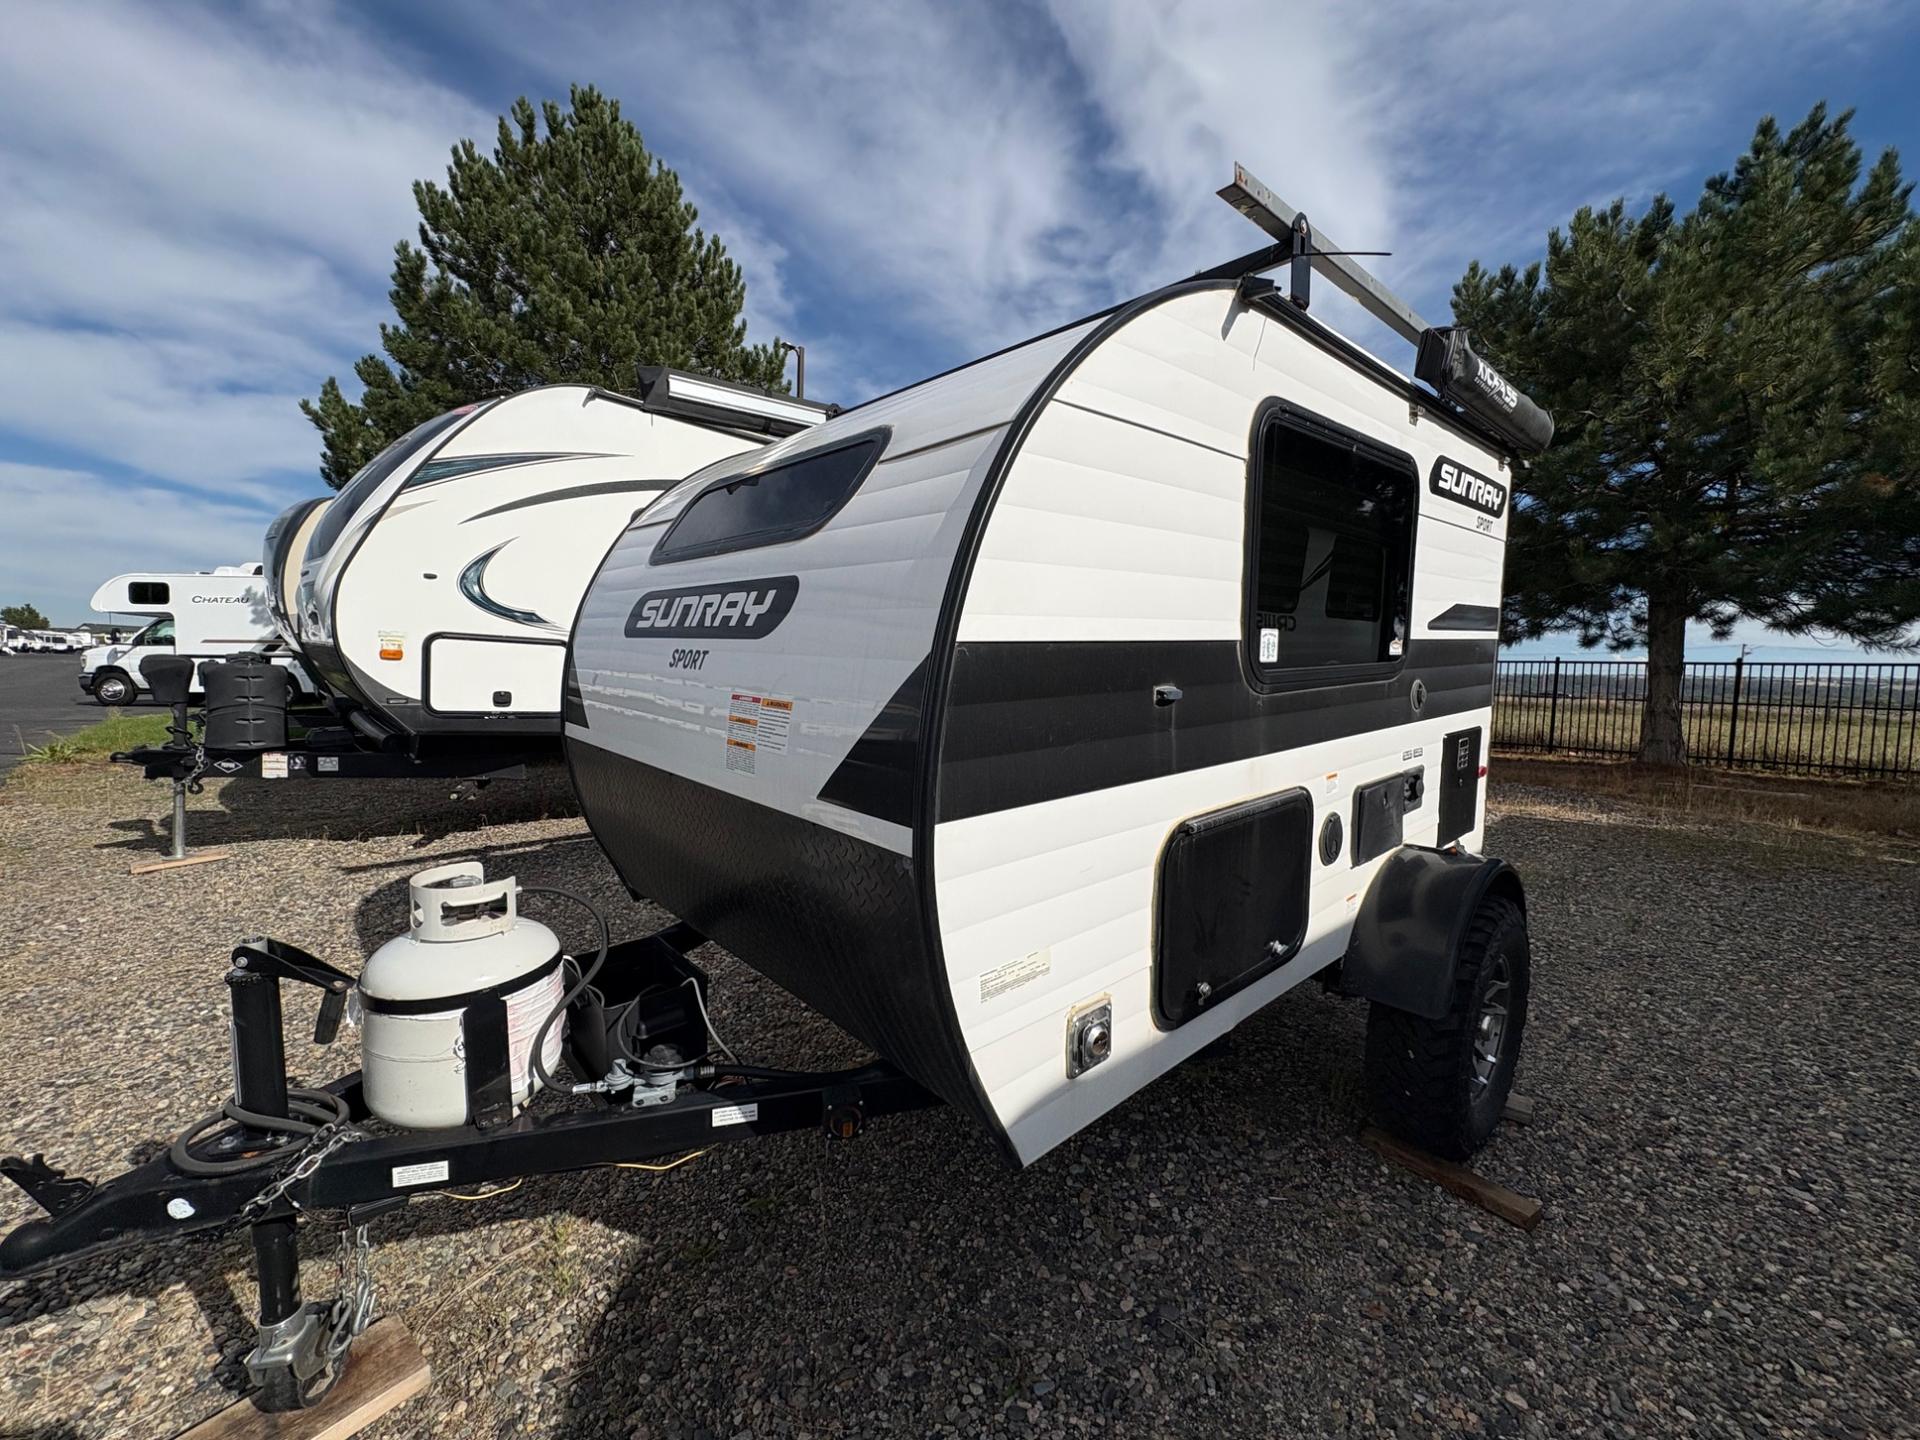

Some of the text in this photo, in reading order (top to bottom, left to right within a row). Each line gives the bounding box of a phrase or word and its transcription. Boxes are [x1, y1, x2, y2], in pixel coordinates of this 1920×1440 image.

[1438, 463, 1503, 511] SUNRAY
[1476, 515, 1494, 533] SPORT
[191, 595, 250, 604] CHATEAU
[635, 589, 777, 628] SUNRAY
[669, 648, 710, 670] SPORT
